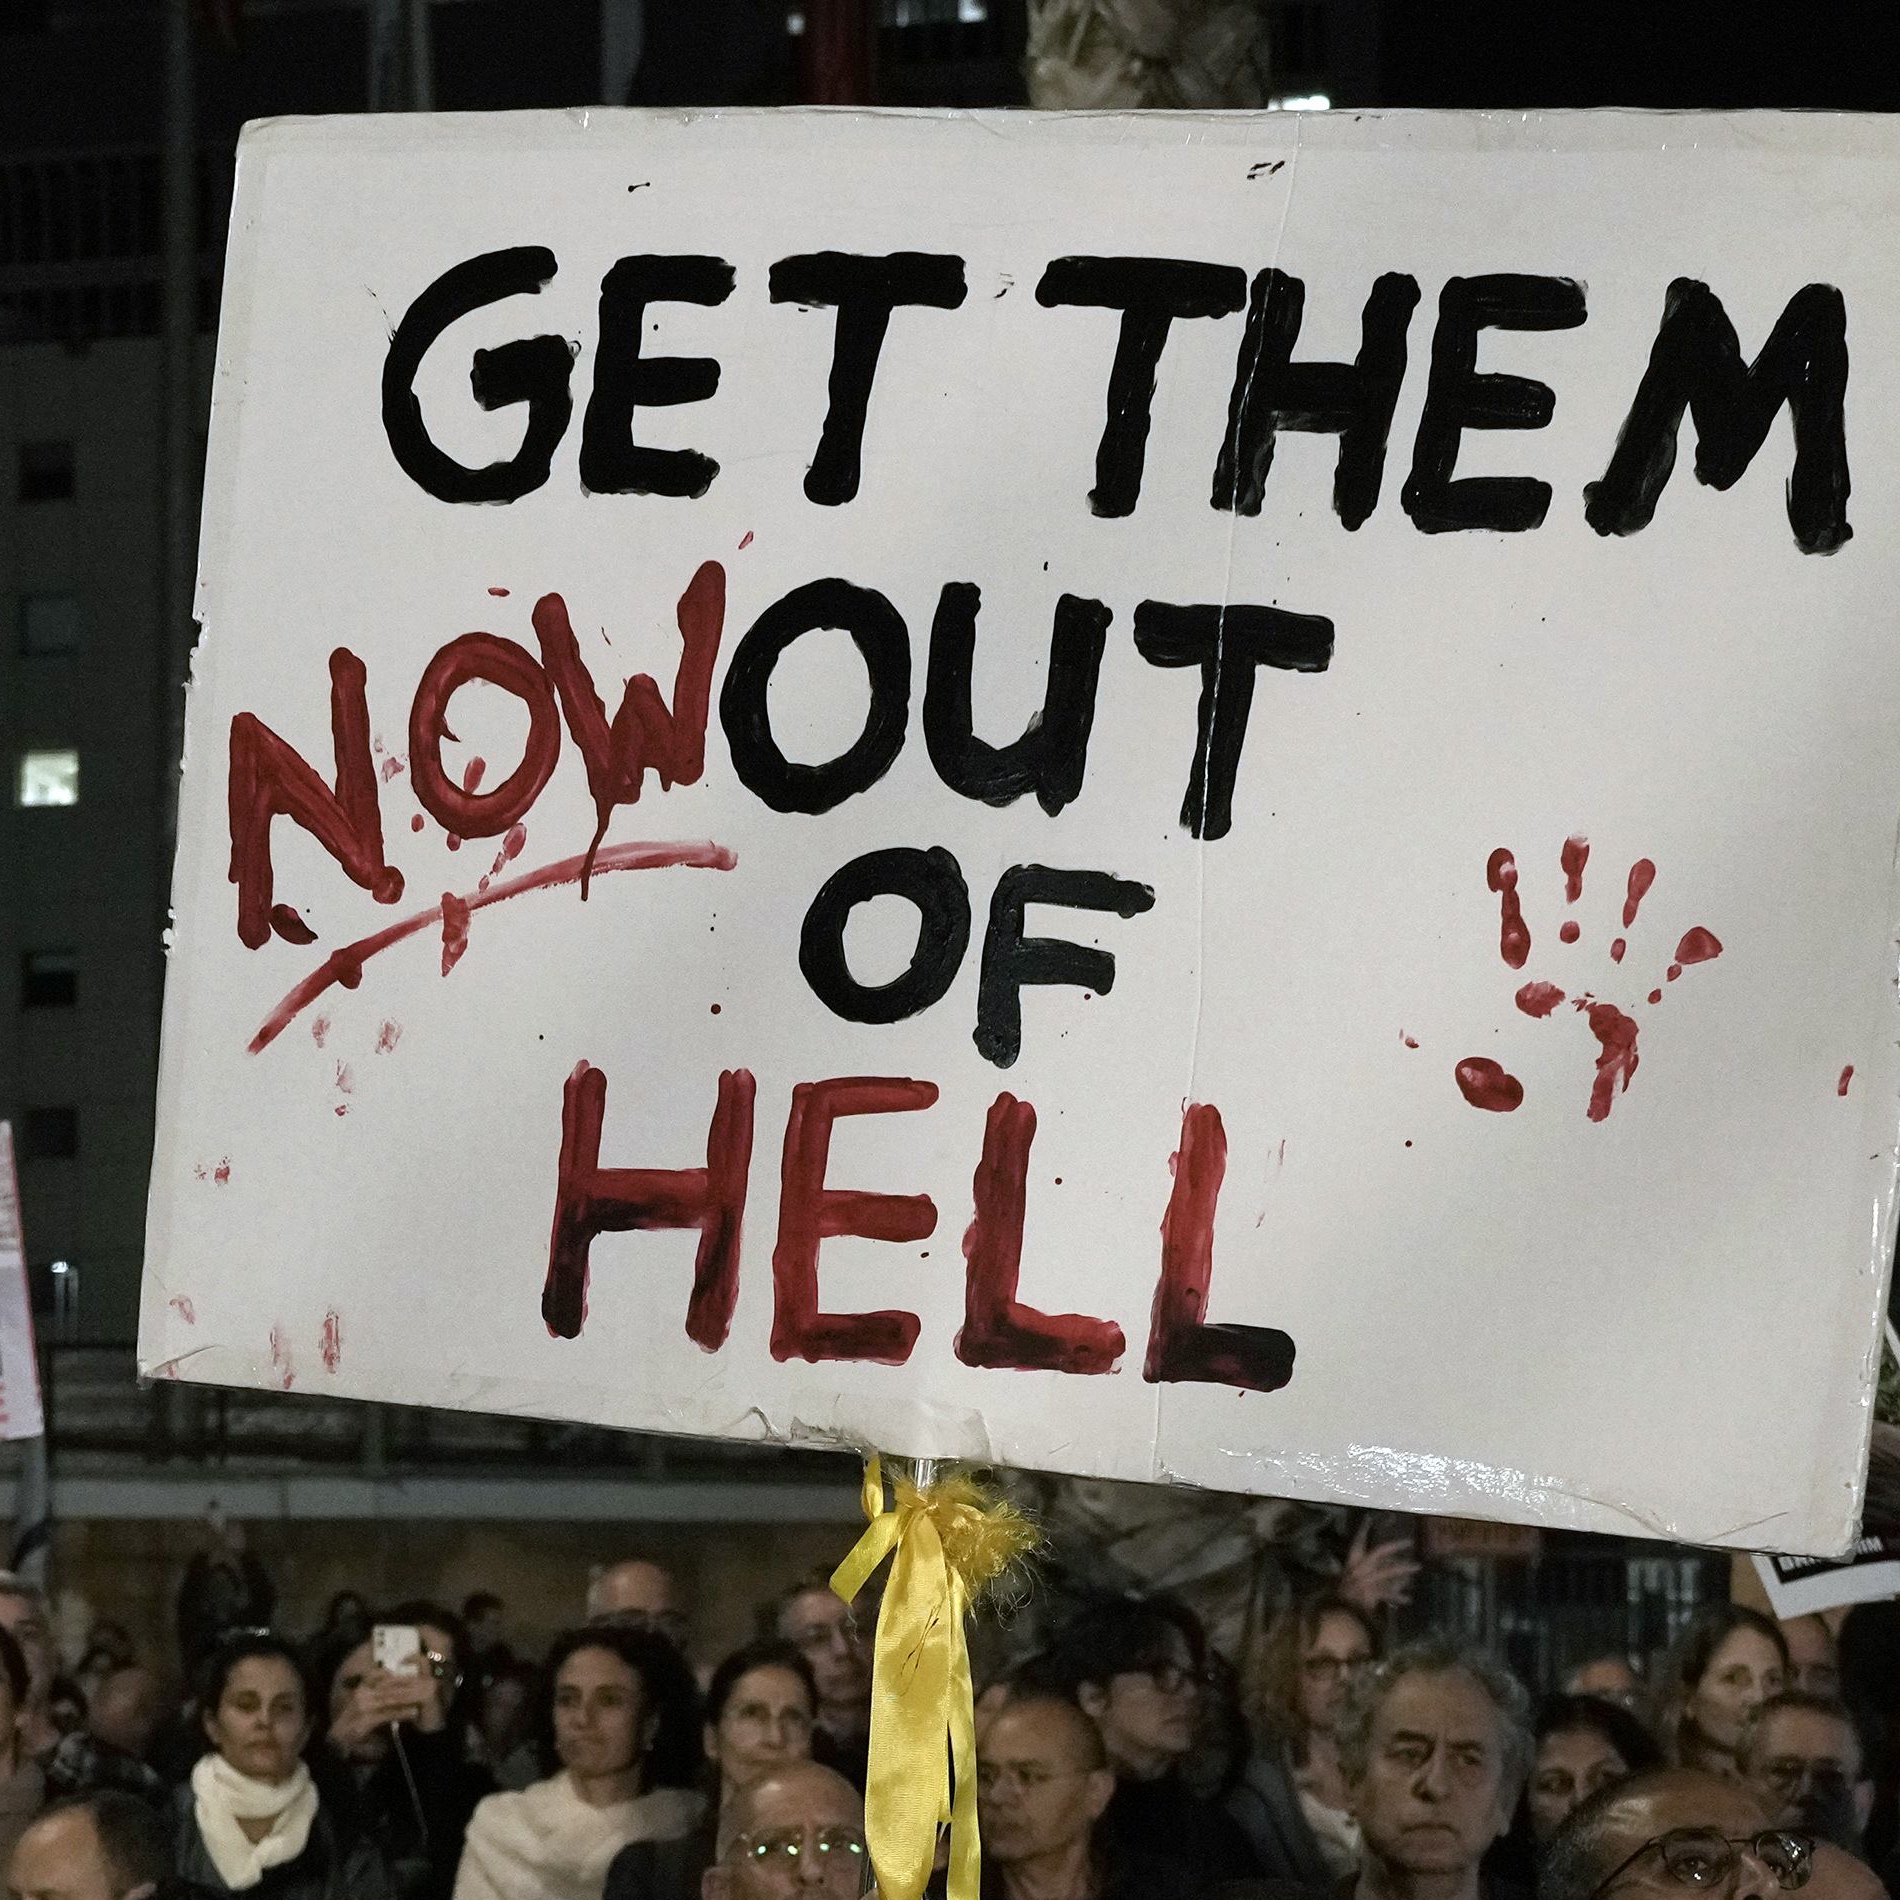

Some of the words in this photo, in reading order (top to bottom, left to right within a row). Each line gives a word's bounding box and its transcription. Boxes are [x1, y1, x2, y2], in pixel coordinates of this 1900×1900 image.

[382, 246, 968, 506] GET
[1035, 256, 1853, 556] THEM
[229, 560, 726, 949] NOW
[719, 576, 1335, 841] OUT
[799, 846, 1155, 1069] OF
[542, 1062, 1296, 1392] HELL
